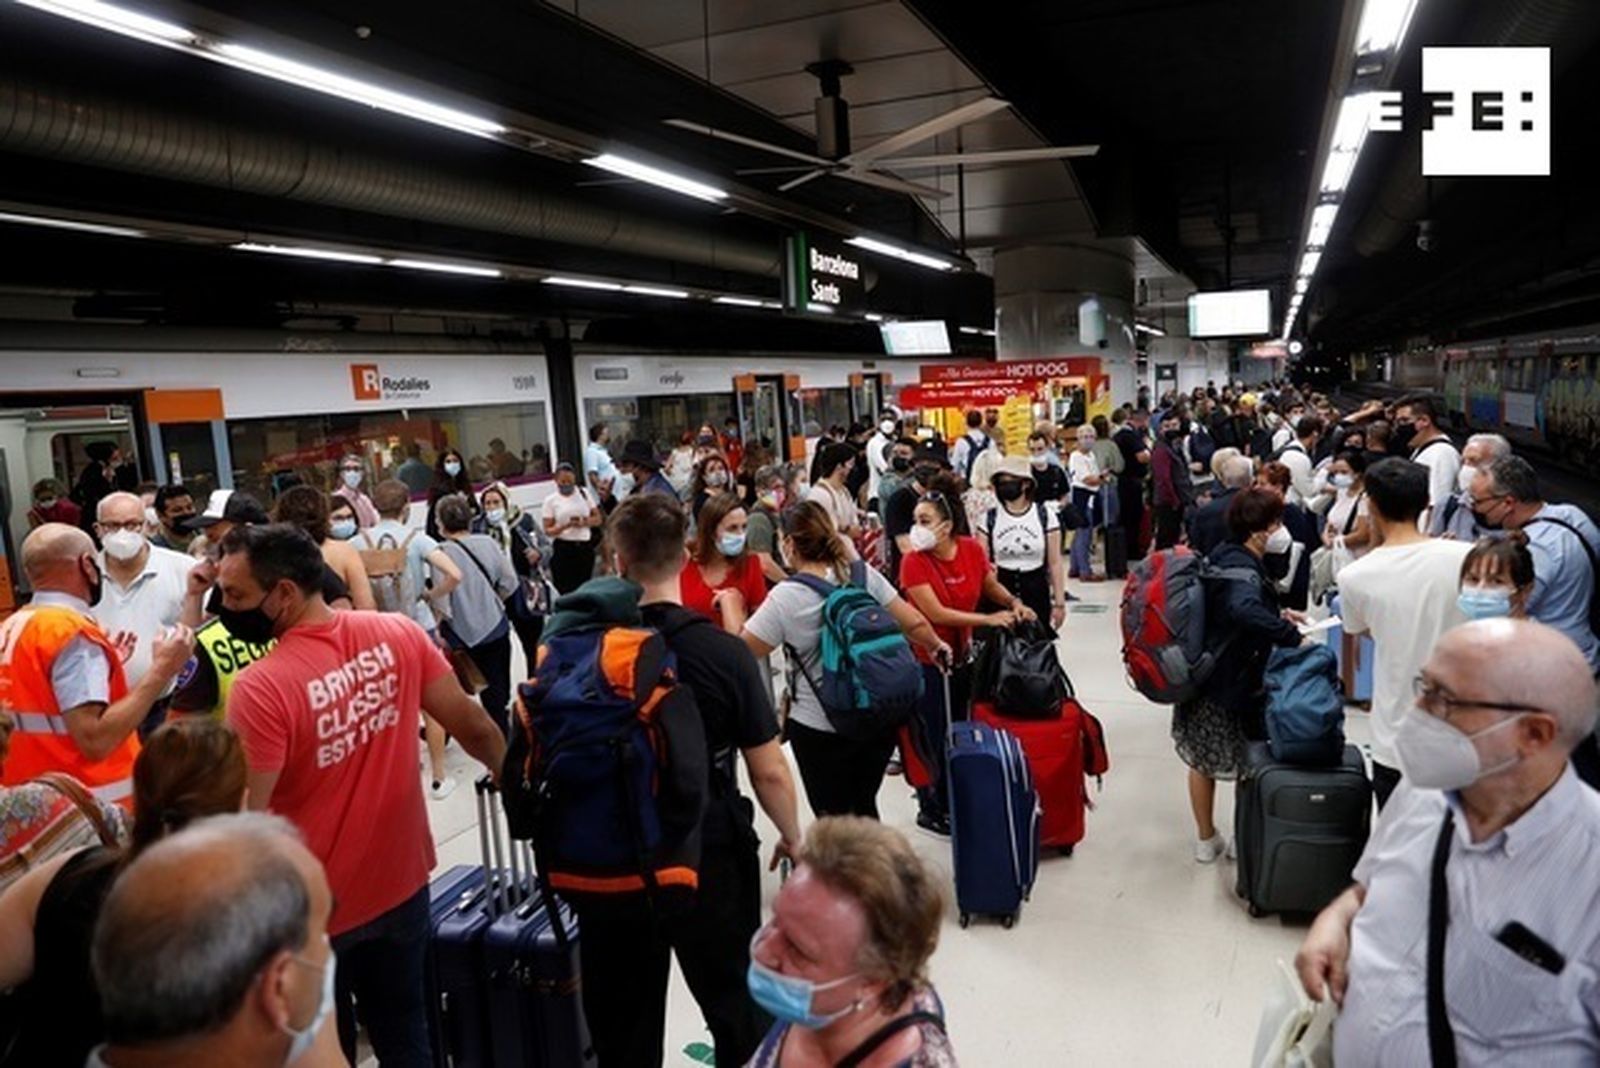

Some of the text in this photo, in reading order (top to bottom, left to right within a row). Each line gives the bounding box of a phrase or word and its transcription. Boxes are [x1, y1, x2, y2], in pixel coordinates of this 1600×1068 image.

[810, 247, 858, 279] Barcelona
[811, 279, 841, 304] Sants
[382, 377, 430, 391] Rodalies
[1006, 364, 1033, 377] HOT
[1035, 362, 1068, 376] DOG
[307, 642, 395, 710] BRITISH
[317, 673, 398, 739] CLASSIC
[317, 731, 357, 769] EST
